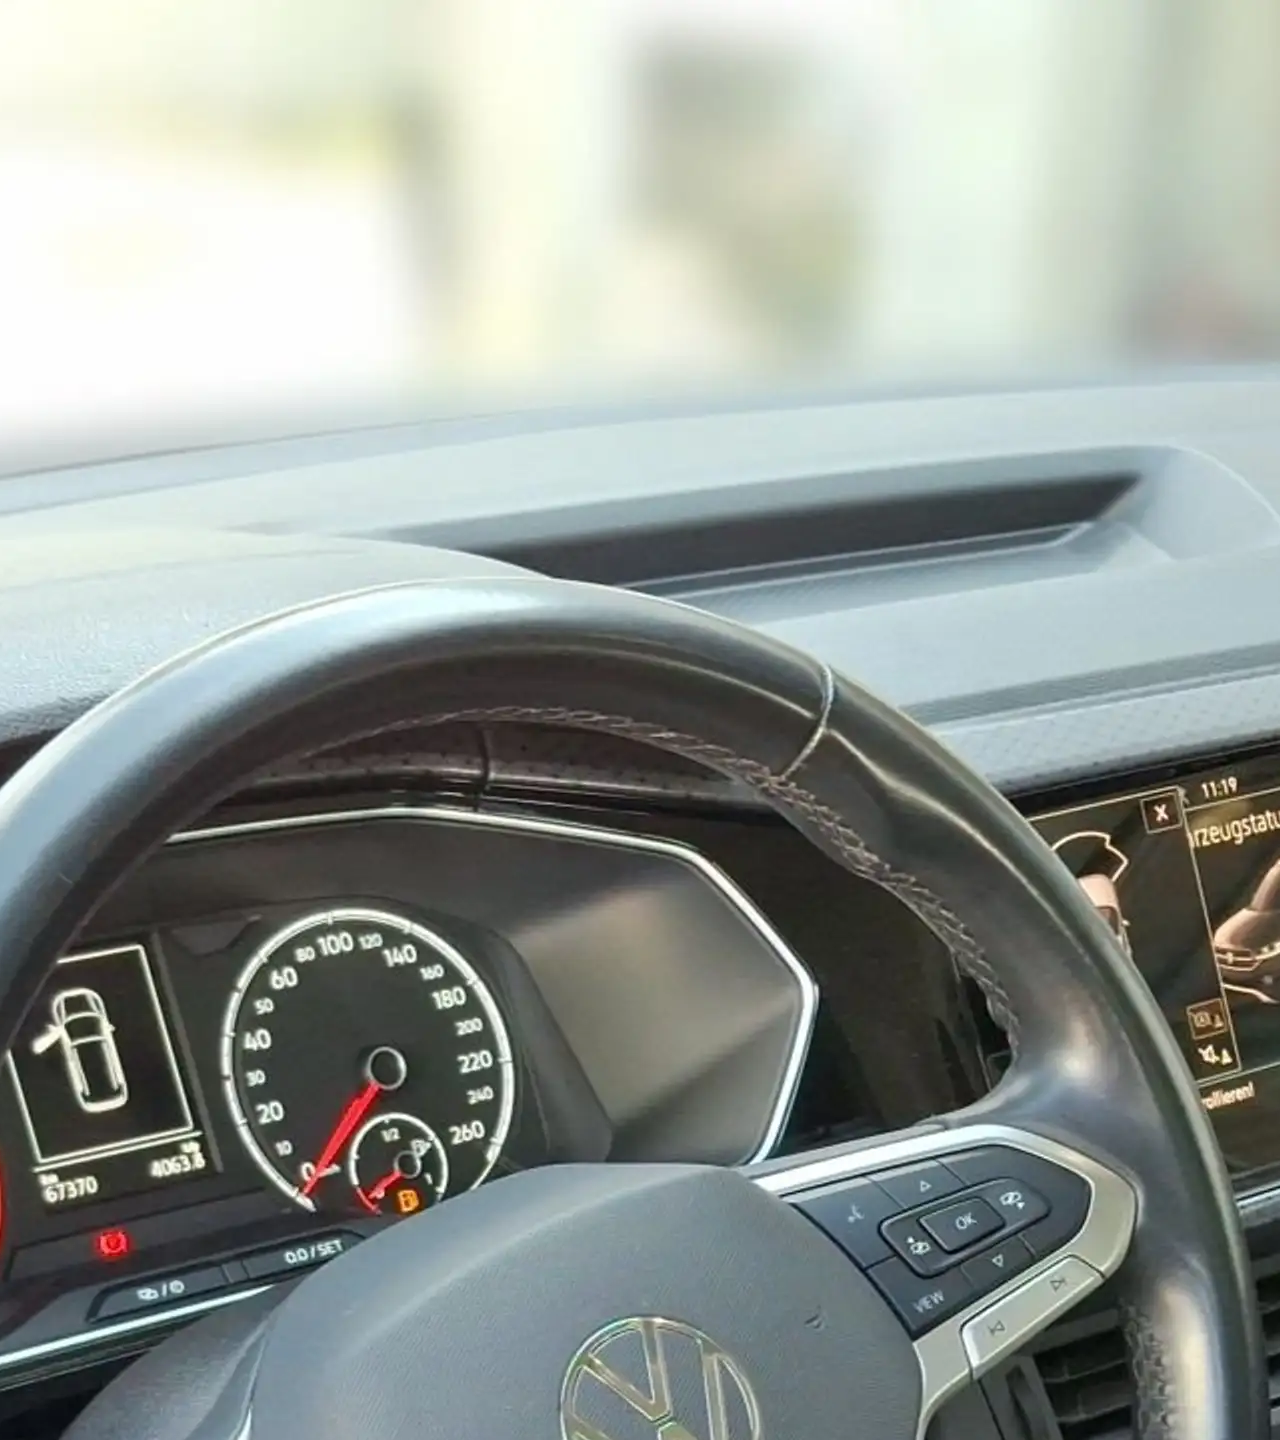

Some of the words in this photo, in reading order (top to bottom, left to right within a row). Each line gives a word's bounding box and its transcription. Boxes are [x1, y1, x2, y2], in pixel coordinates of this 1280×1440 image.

[1201, 776, 1239, 799] 11:19
[317, 931, 354, 957] 100
[358, 932, 383, 950] 120
[294, 946, 316, 963] 80
[381, 944, 418, 968] 140
[270, 966, 298, 990] 60
[419, 963, 445, 981] 160
[253, 997, 275, 1015] 50
[431, 985, 467, 1010] 180
[454, 1017, 484, 1037] 200
[243, 1028, 272, 1051] 40
[456, 1049, 494, 1075] 220
[245, 1069, 267, 1087] 30
[466, 1085, 495, 1105] 240
[256, 1100, 285, 1124] 20
[449, 1119, 486, 1146] 260
[275, 1140, 293, 1157] 10
[300, 1161, 318, 1182] 0
[43, 1175, 98, 1203] 67370
[954, 1211, 978, 1231] OK
[317, 1239, 344, 1256] SET
[913, 1290, 946, 1314] VIEW
